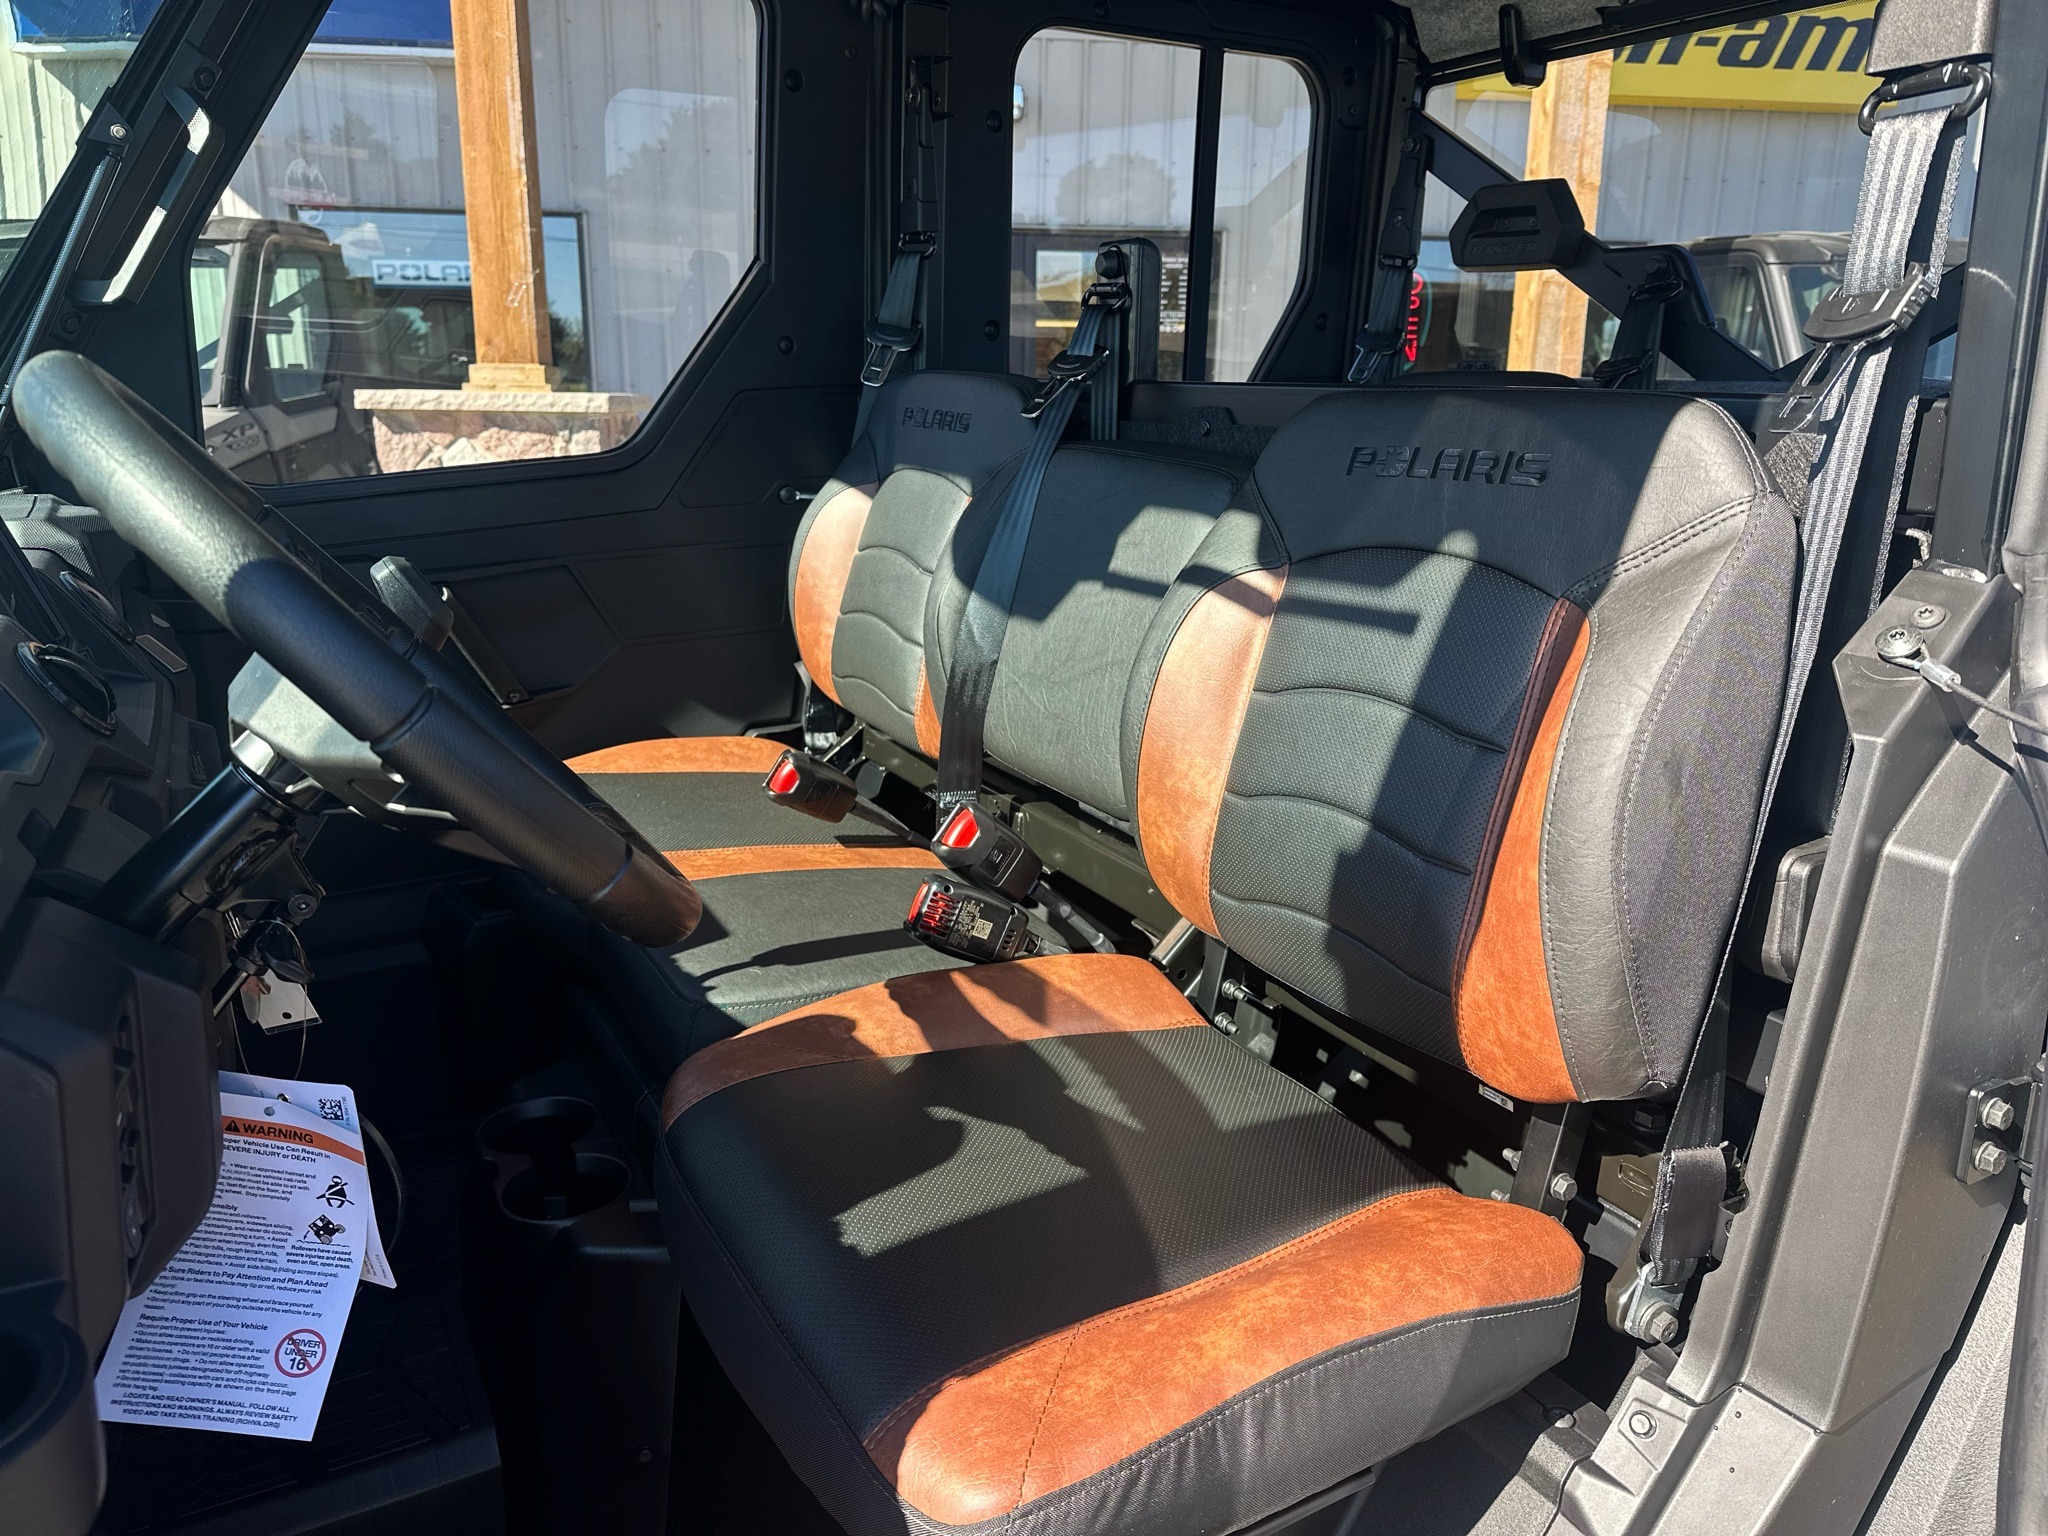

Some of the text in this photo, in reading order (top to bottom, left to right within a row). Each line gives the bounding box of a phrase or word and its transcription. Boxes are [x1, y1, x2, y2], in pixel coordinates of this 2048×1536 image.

[902, 406, 972, 434] POLARIS
[221, 423, 255, 443] XP
[1345, 445, 1552, 488] POLARIS
[242, 1123, 314, 1144] WARNING
[223, 1144, 252, 1154] SEVERE
[252, 1148, 281, 1158] INJURY
[291, 1154, 316, 1163] DEATH
[243, 1139, 269, 1149] Vehicle
[270, 1142, 285, 1151] Use
[286, 1145, 300, 1153] Can
[301, 1148, 324, 1158] Result
[168, 1266, 186, 1274] Sure
[187, 1268, 211, 1277] Riders
[221, 1271, 237, 1279] Pay
[236, 1273, 271, 1282] Attention
[304, 1280, 328, 1288] Ahead
[139, 1313, 170, 1323] Require
[170, 1316, 197, 1326] Proper
[198, 1318, 212, 1326] Use
[222, 1320, 240, 1328] Your
[240, 1322, 268, 1331] Vehicle
[287, 1338, 321, 1348] DRIVER
[285, 1348, 317, 1358] UNDER
[290, 1357, 306, 1370] 16
[185, 1396, 216, 1405] OWNER'S
[217, 1400, 248, 1408] MANUAL.
[248, 1403, 278, 1411] FOLLOW
